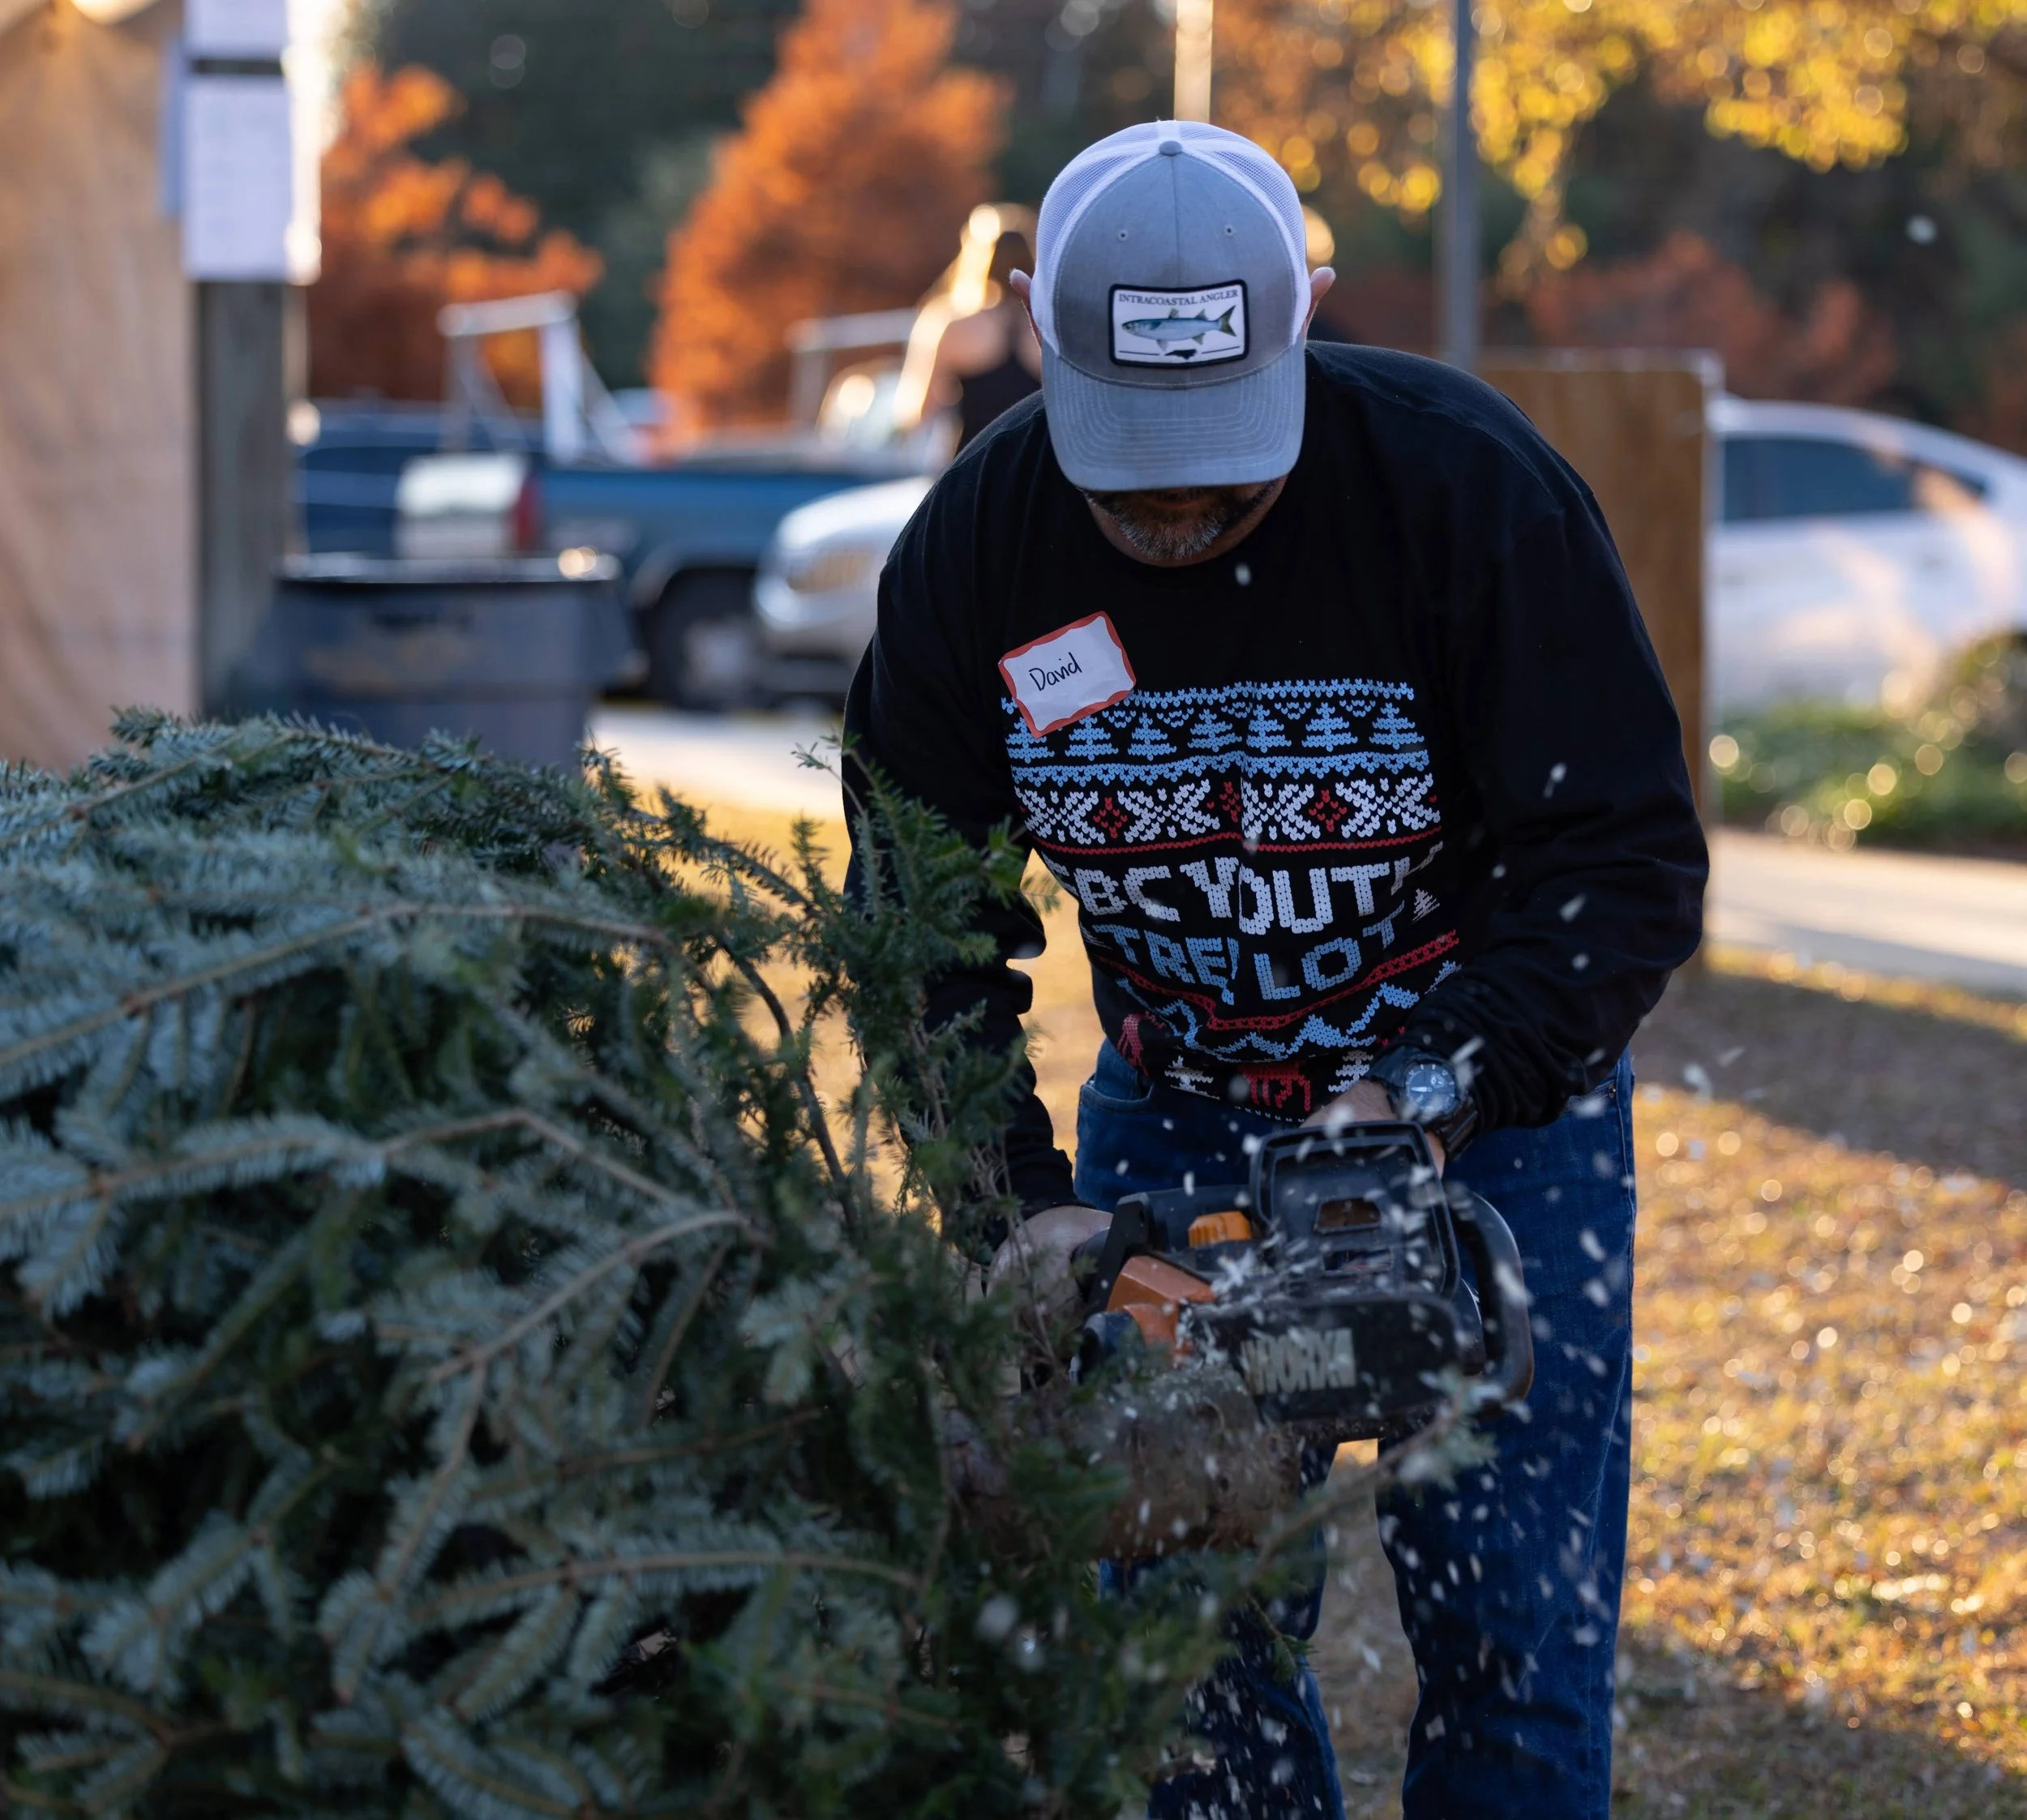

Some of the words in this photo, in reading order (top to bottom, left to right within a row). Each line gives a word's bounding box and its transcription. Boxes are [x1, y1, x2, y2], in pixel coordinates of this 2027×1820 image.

[1119, 293, 1198, 306] INTRACOASTAL
[1199, 289, 1238, 302] ANGLER
[1029, 652, 1082, 692] David
[1253, 901, 1405, 1000] LOT
